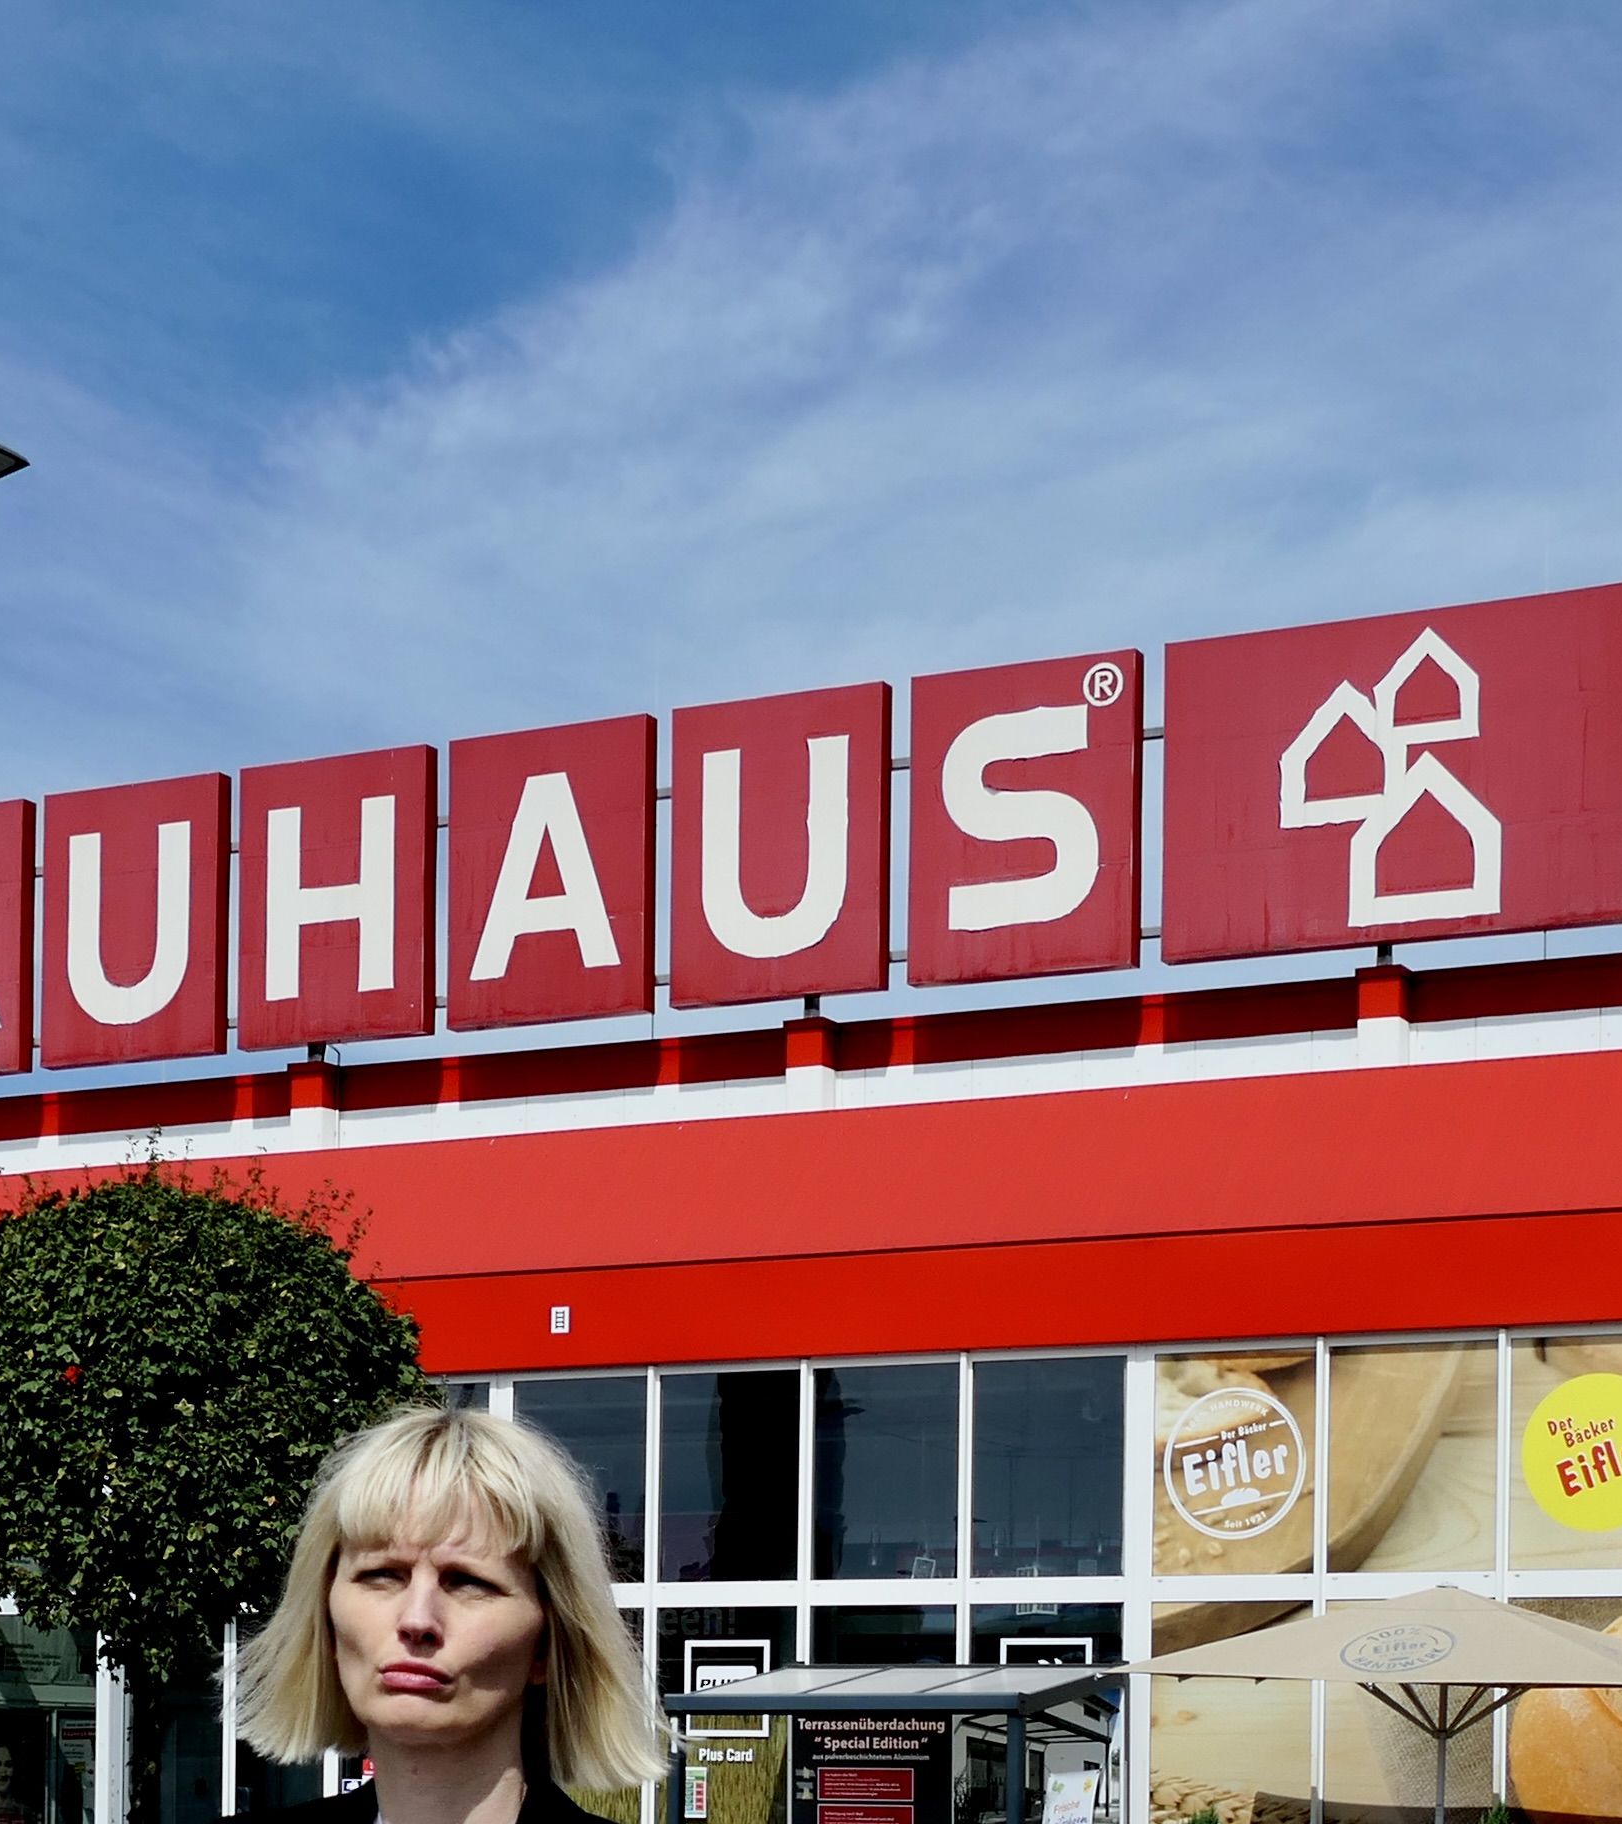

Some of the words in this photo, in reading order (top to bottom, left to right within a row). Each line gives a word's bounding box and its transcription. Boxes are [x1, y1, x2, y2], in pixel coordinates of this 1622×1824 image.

[1210, 1399, 1269, 1417] HANDWERK
[1220, 1430, 1236, 1441] Der
[1237, 1422, 1267, 1437] Bäcker
[1546, 1417, 1573, 1437] Der
[1562, 1418, 1615, 1448] Bäcker
[1182, 1439, 1288, 1496] Eifler
[1224, 1519, 1242, 1529] Seit
[1366, 1627, 1422, 1641] 100%
[700, 1678, 741, 1688] PLU
[797, 1718, 946, 1734] Terrassenüberdachung
[698, 1748, 724, 1762] Plus
[726, 1748, 754, 1763] Card
